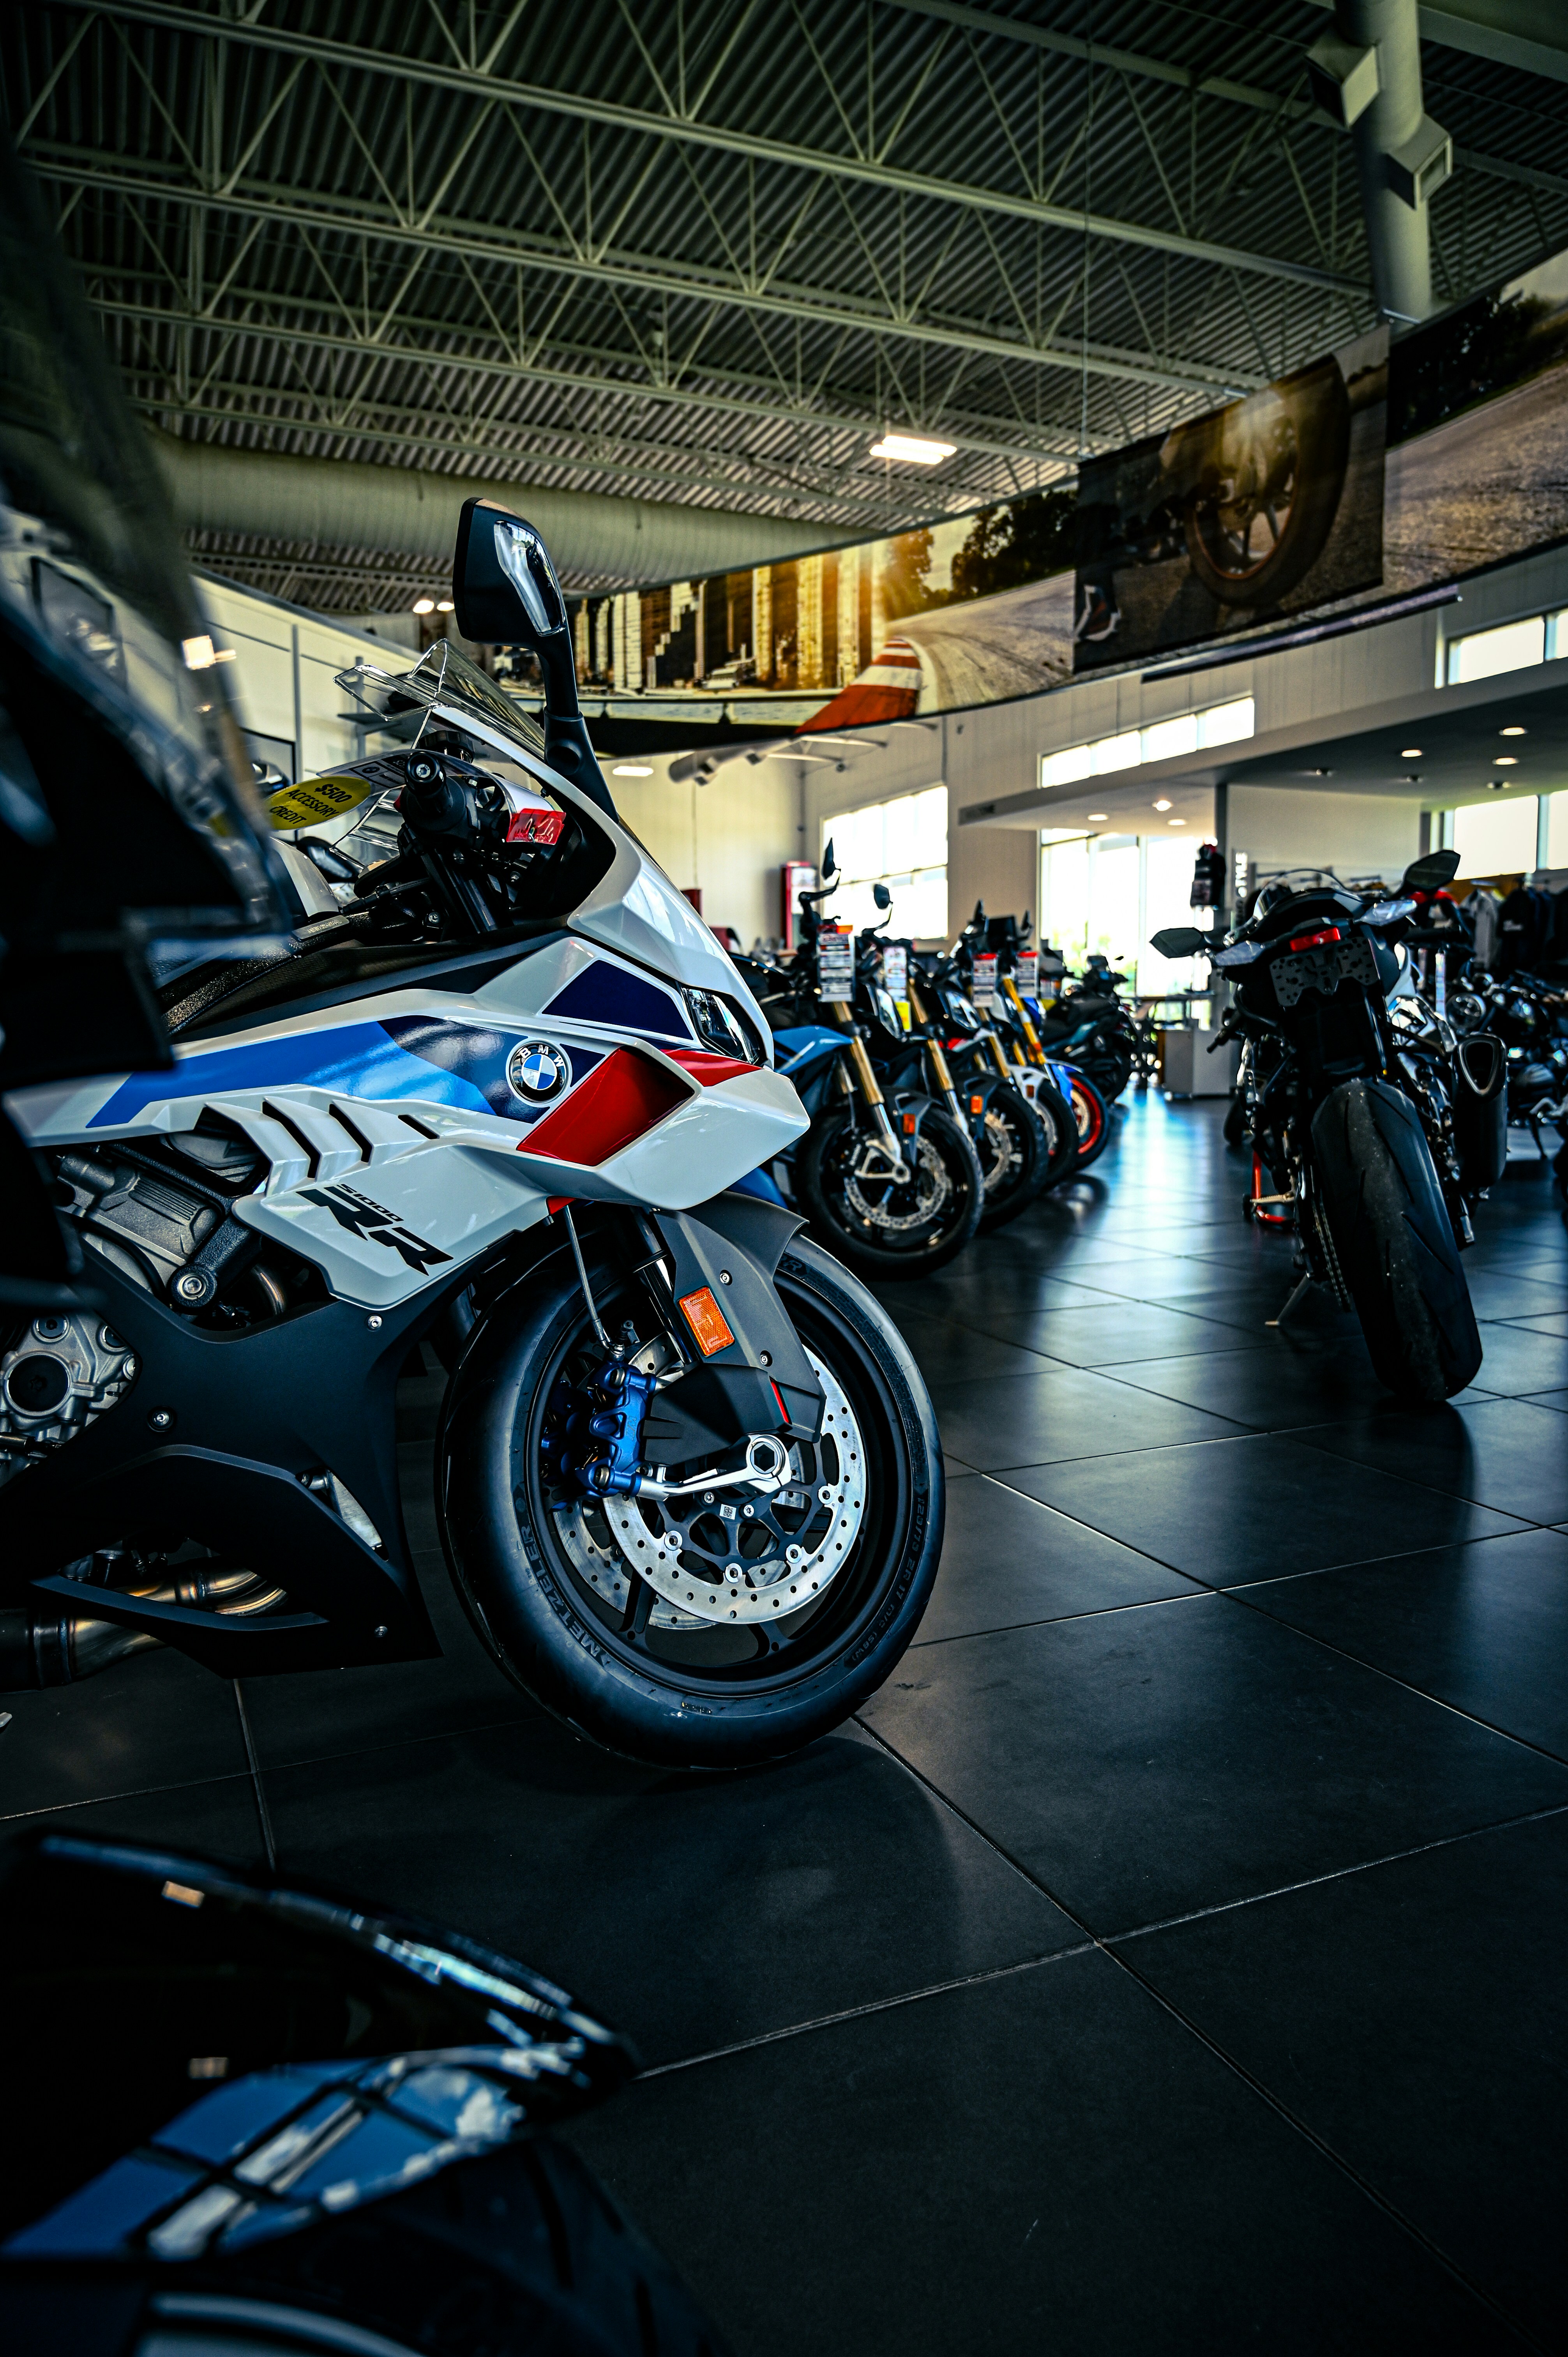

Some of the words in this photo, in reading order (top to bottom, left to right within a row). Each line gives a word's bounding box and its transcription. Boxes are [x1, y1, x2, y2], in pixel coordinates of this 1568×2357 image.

[286, 790, 339, 817] ACCESSORY
[314, 784, 352, 803] $500
[269, 806, 307, 824] CREDIT
[519, 1044, 565, 1067] BMW
[337, 1184, 404, 1222] S1000
[295, 1186, 454, 1276] RR
[912, 1498, 925, 1551] 120/70
[903, 1557, 915, 1581] ZR
[521, 1525, 601, 1657] METZELER
[896, 1585, 906, 1599] 17
